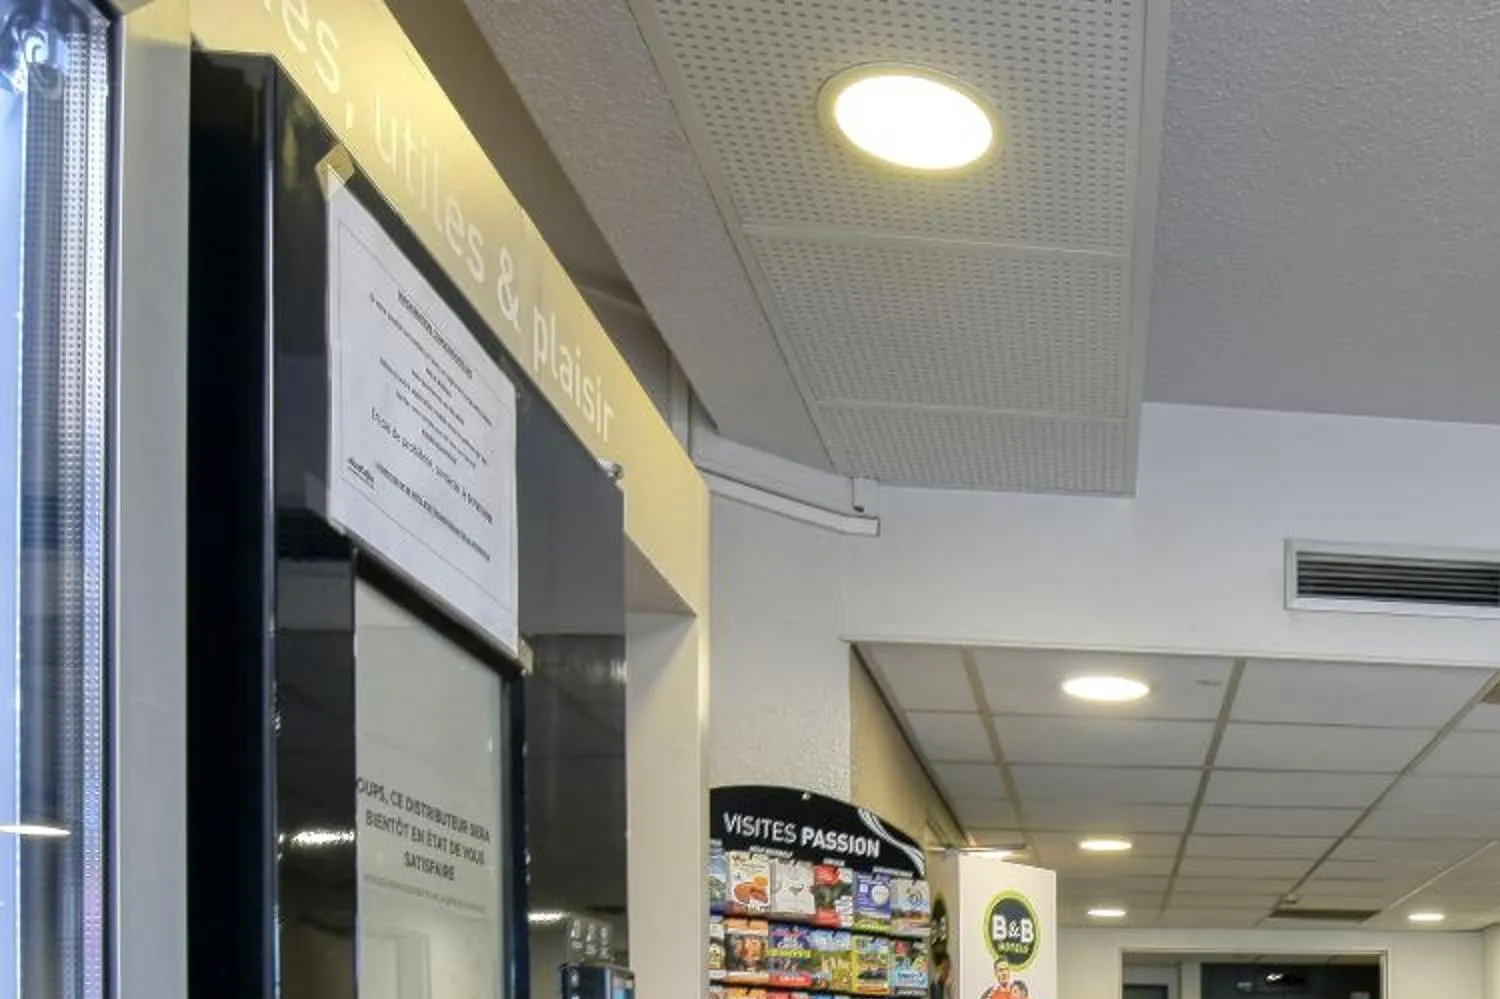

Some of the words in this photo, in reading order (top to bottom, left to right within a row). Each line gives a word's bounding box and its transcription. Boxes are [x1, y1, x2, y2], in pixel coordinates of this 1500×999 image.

[373, 92, 485, 284] utiles
[497, 248, 521, 336] &
[533, 306, 616, 444] plaisir
[365, 809, 410, 840] BIENTÔT
[411, 825, 425, 845] EN
[450, 840, 462, 857] DE
[390, 788, 404, 810] CE
[405, 796, 469, 835] DISTRIBUTEUR
[722, 811, 798, 844] VISITES
[801, 827, 880, 858] PASSION
[404, 851, 456, 881] SATISFAIRE
[992, 915, 1034, 943] B&B
